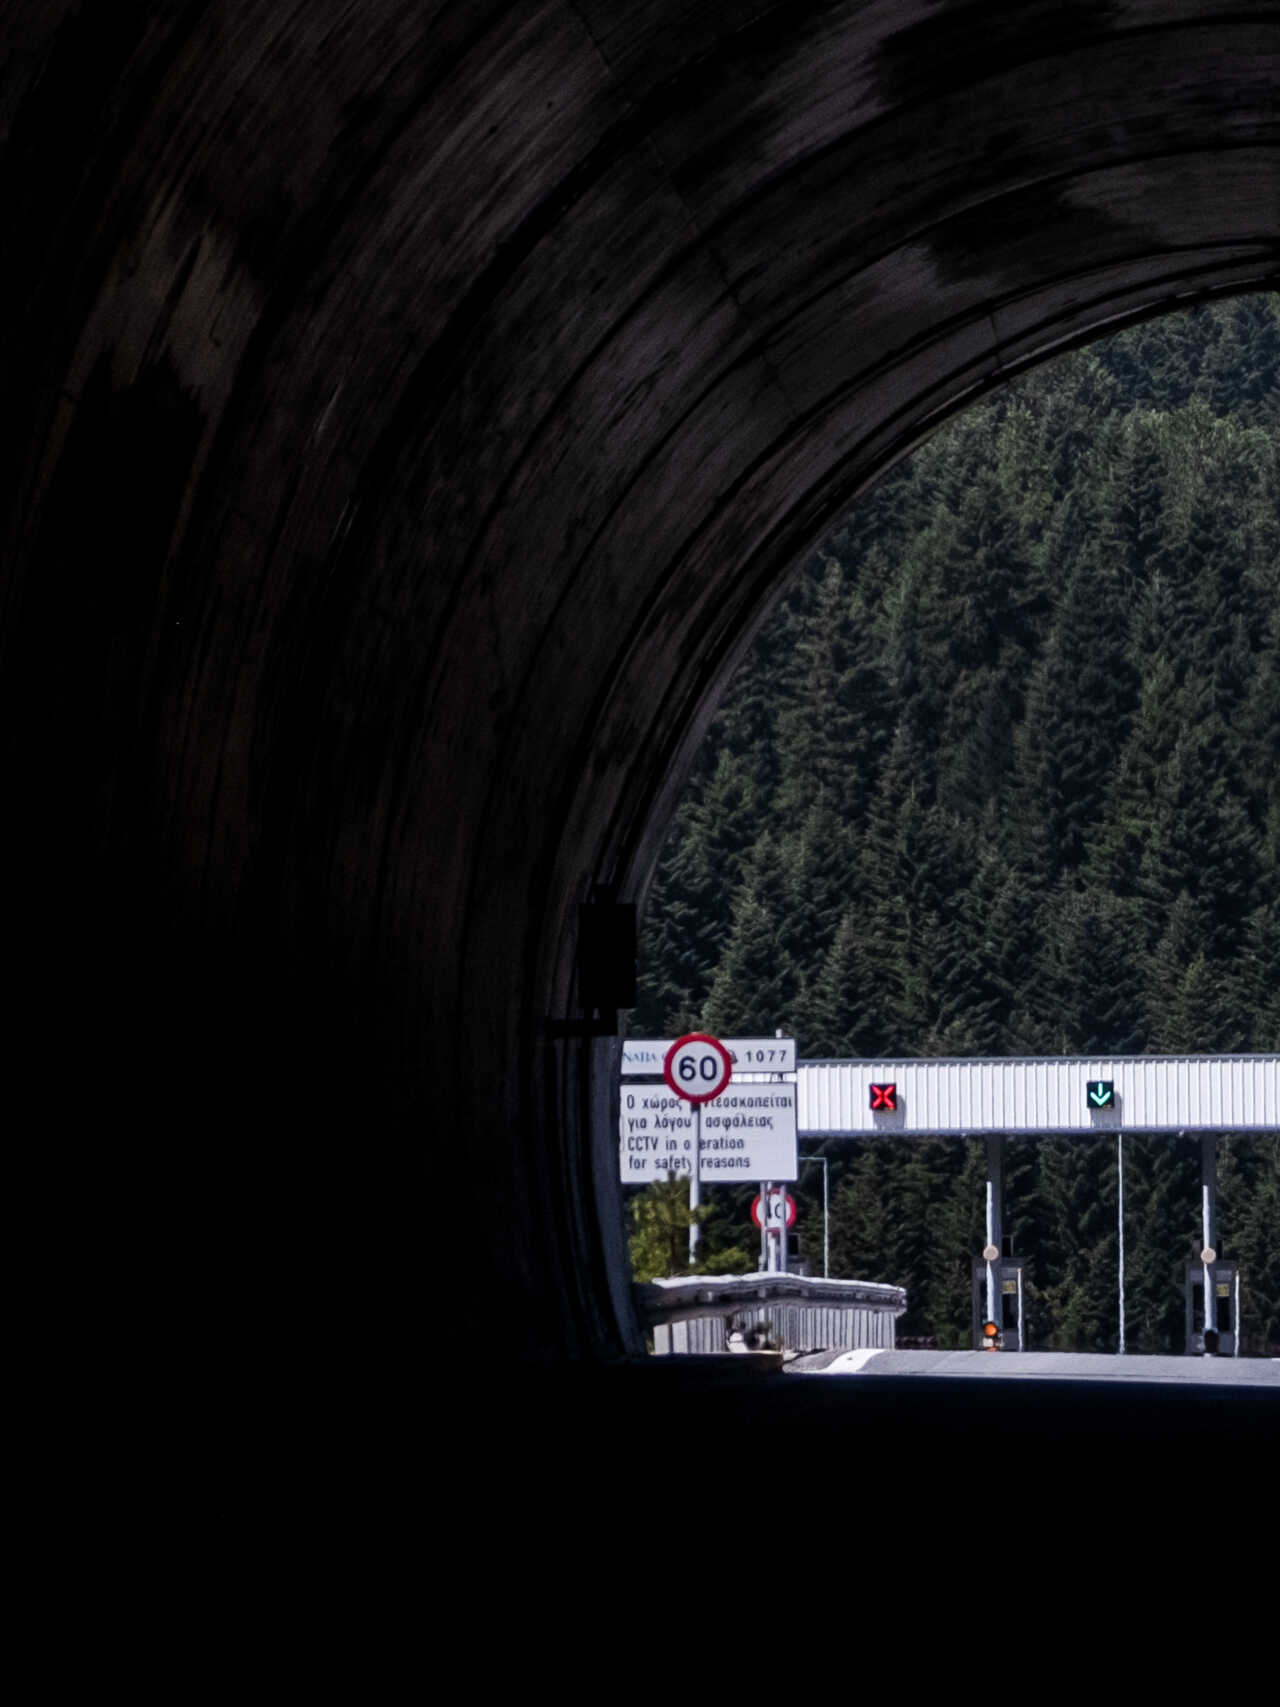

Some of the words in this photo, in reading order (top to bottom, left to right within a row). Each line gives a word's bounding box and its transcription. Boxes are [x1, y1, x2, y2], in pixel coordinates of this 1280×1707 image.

[746, 1049, 787, 1063] 1077
[679, 1055, 718, 1081] 60
[628, 1117, 647, 1132] για
[654, 1114, 692, 1132] λόγου
[627, 1136, 658, 1151] CCTV
[666, 1137, 677, 1150] in
[683, 1137, 745, 1150] oeration
[629, 1154, 647, 1169] for
[700, 1156, 751, 1169] reasons
